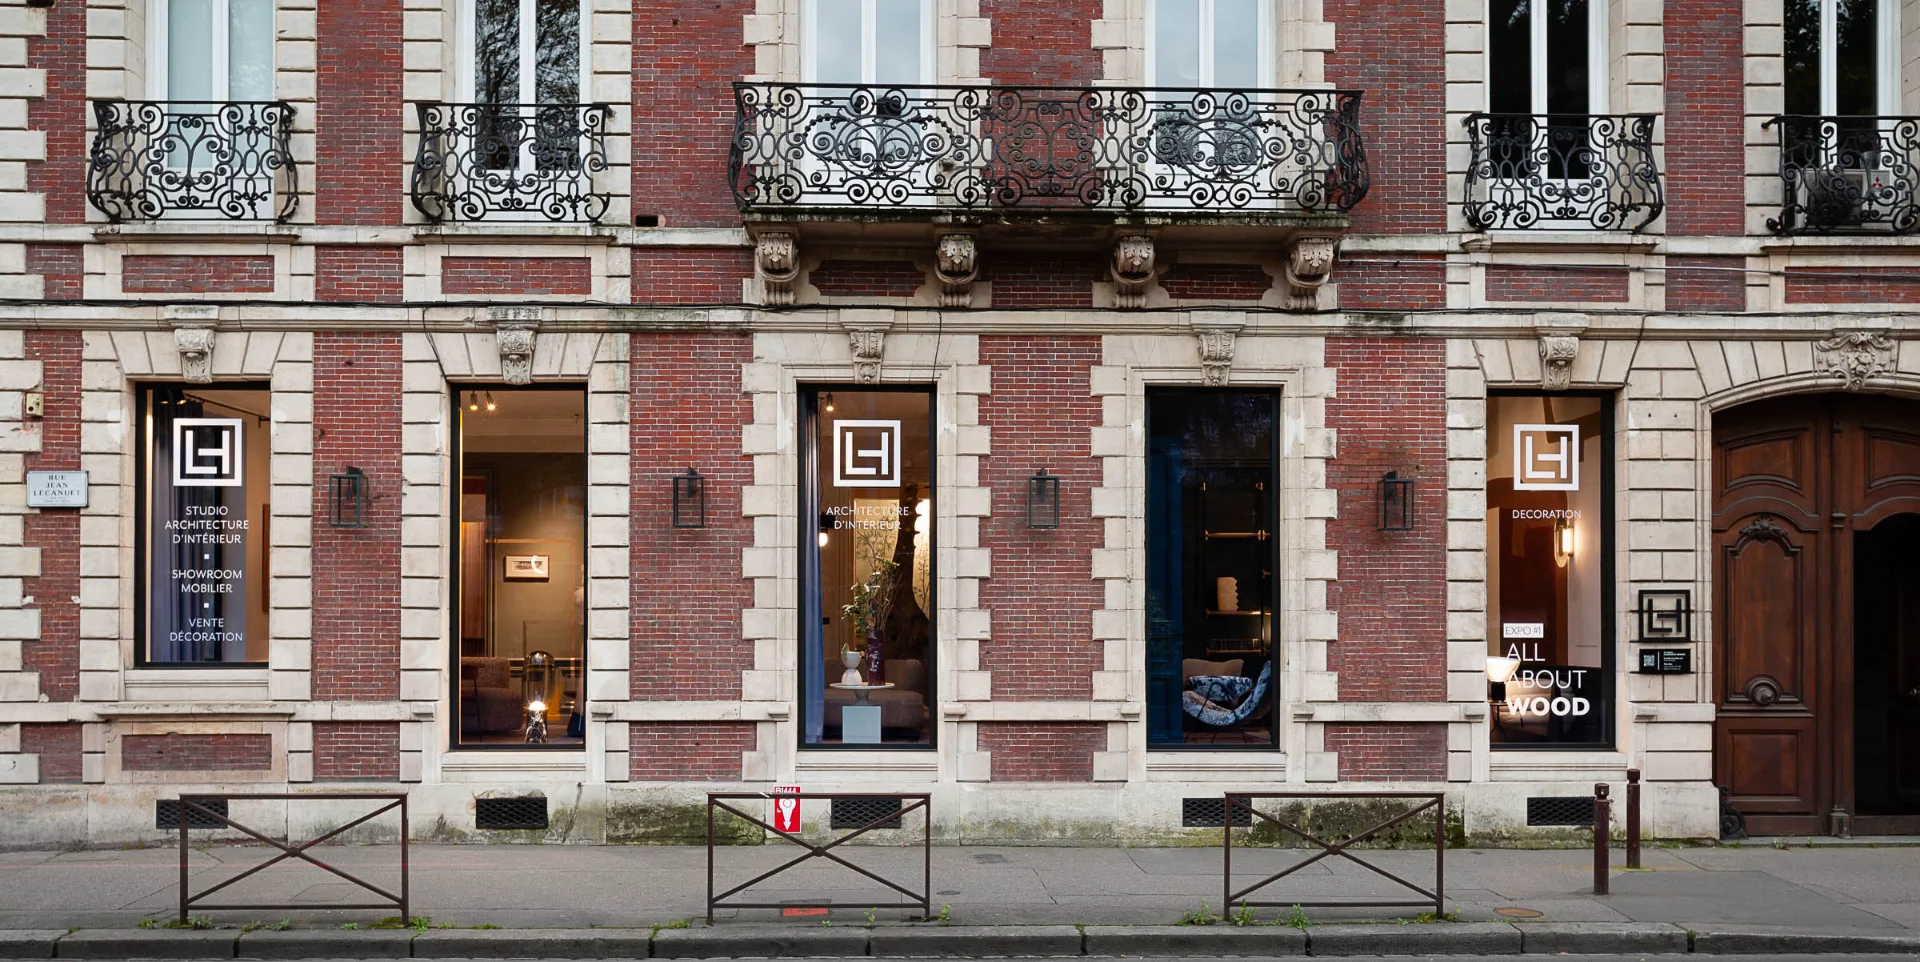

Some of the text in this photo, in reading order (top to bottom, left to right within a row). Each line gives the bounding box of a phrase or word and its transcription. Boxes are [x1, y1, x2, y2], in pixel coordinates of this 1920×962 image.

[33, 489, 81, 497] LECANUET
[185, 505, 229, 516] STUDIO
[826, 506, 909, 516] ARCHITECTURE
[1512, 509, 1582, 519] DECORATION
[164, 519, 250, 530] ARCHITECTURE
[834, 519, 902, 530] D'INTÉRIEUR
[172, 532, 242, 544] D'INTÉRIEUR
[172, 569, 243, 580] SHOWROOM
[181, 583, 233, 593] MOBILIER
[188, 618, 225, 628] VENTE
[169, 630, 243, 642] DÉCORATION
[1505, 626, 1541, 636] EXPO #1
[1506, 642, 1546, 662] ALL
[1508, 669, 1588, 689] ABOUT
[1505, 696, 1591, 717] WOOD
